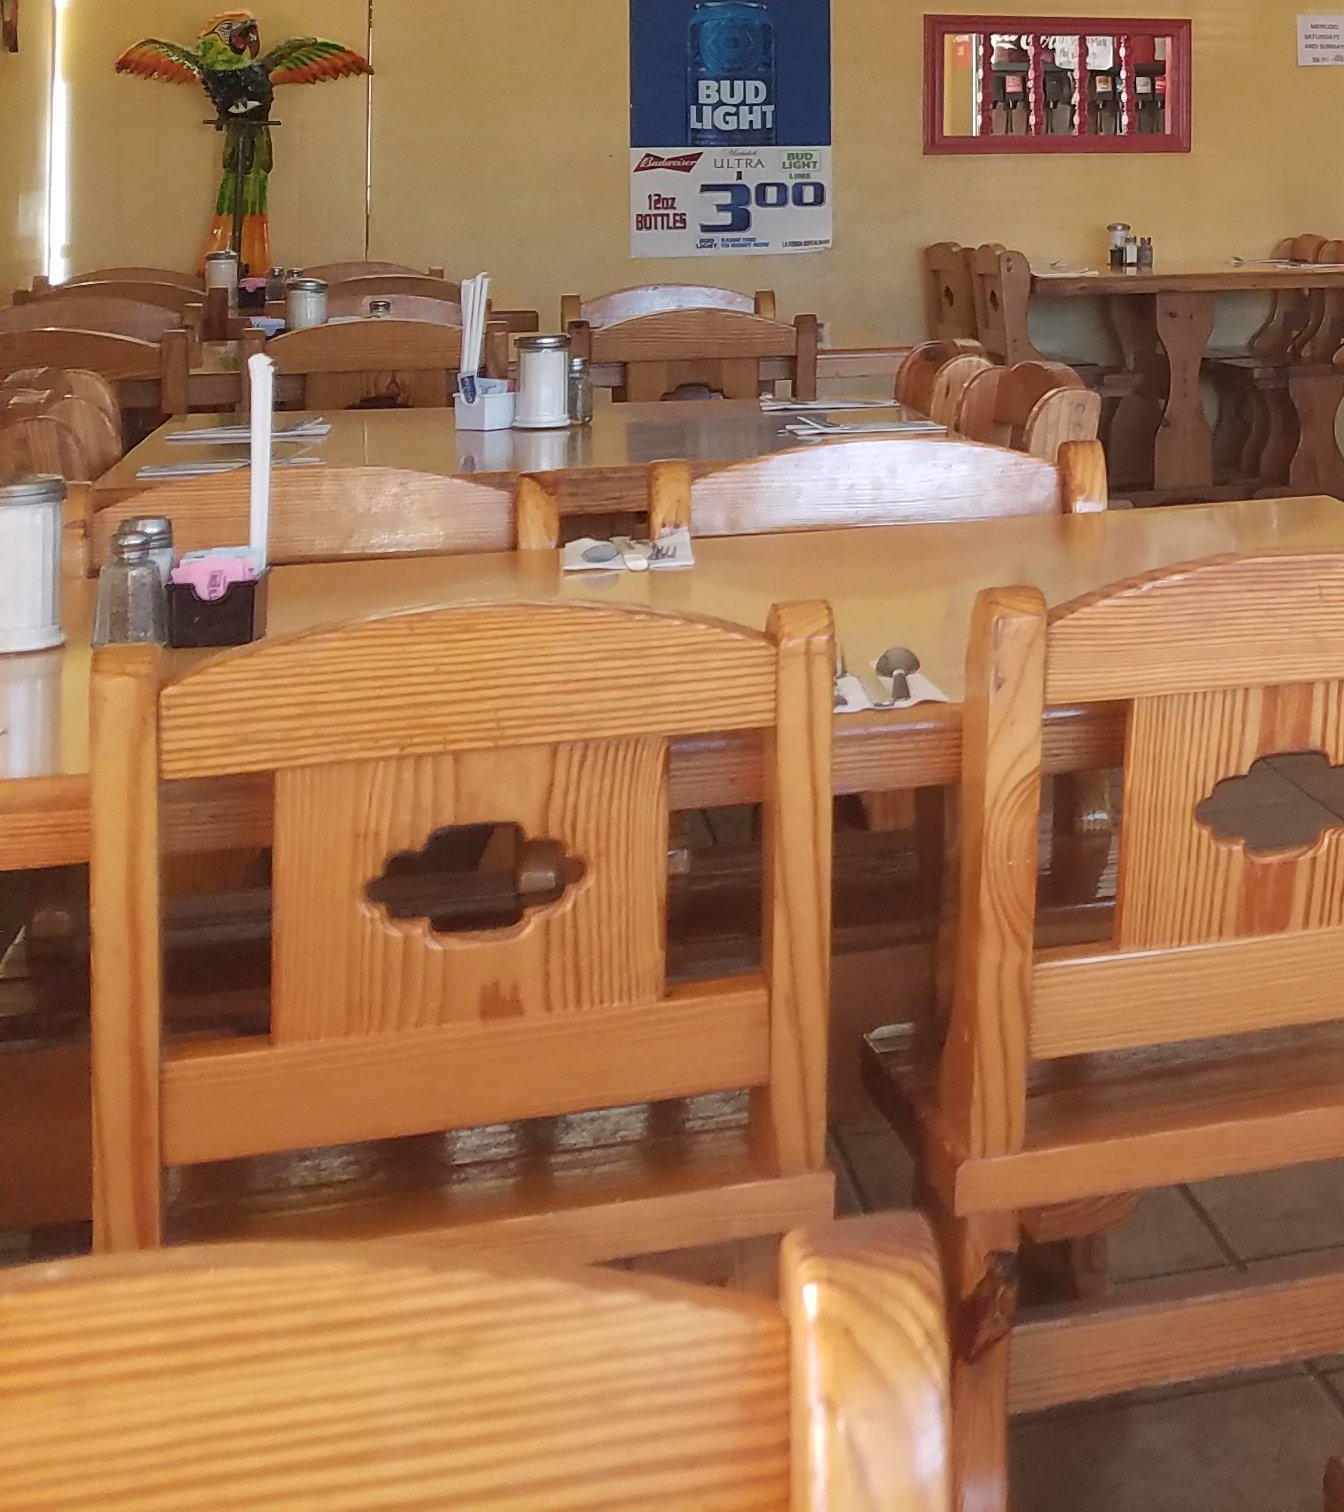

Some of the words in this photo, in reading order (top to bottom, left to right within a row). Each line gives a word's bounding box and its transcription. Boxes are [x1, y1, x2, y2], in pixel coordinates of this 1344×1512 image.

[698, 80, 767, 105] BUD
[689, 105, 774, 131] LIGHT
[639, 155, 699, 169] Budweiser
[713, 157, 766, 169] ULTRA
[786, 152, 814, 162] BUD
[781, 161, 821, 170] LIGHT
[635, 213, 687, 231] BOTTLES
